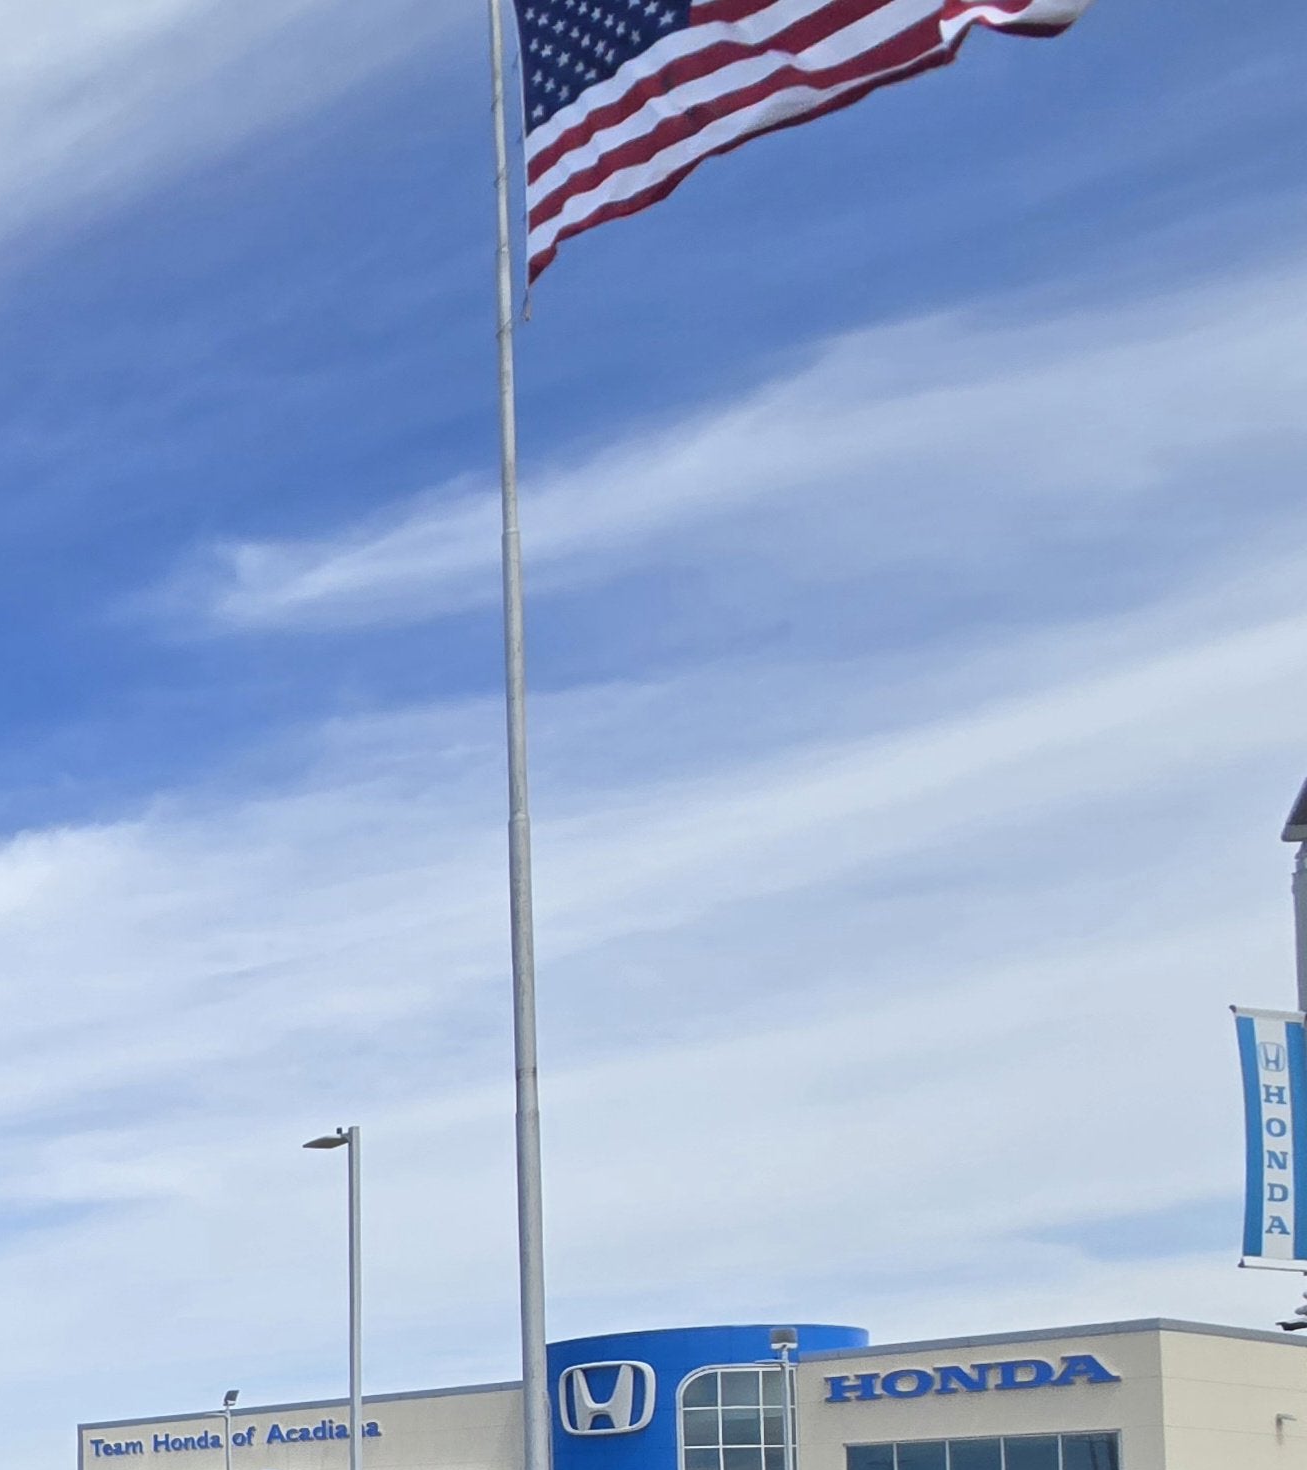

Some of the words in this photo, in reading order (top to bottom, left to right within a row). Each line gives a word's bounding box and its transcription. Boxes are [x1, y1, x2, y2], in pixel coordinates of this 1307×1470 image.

[1261, 1083, 1291, 1236] HONDA
[824, 1354, 1121, 1404] HONDA
[90, 1438, 145, 1458] Team
[153, 1430, 223, 1453] Honda
[232, 1426, 257, 1447] of
